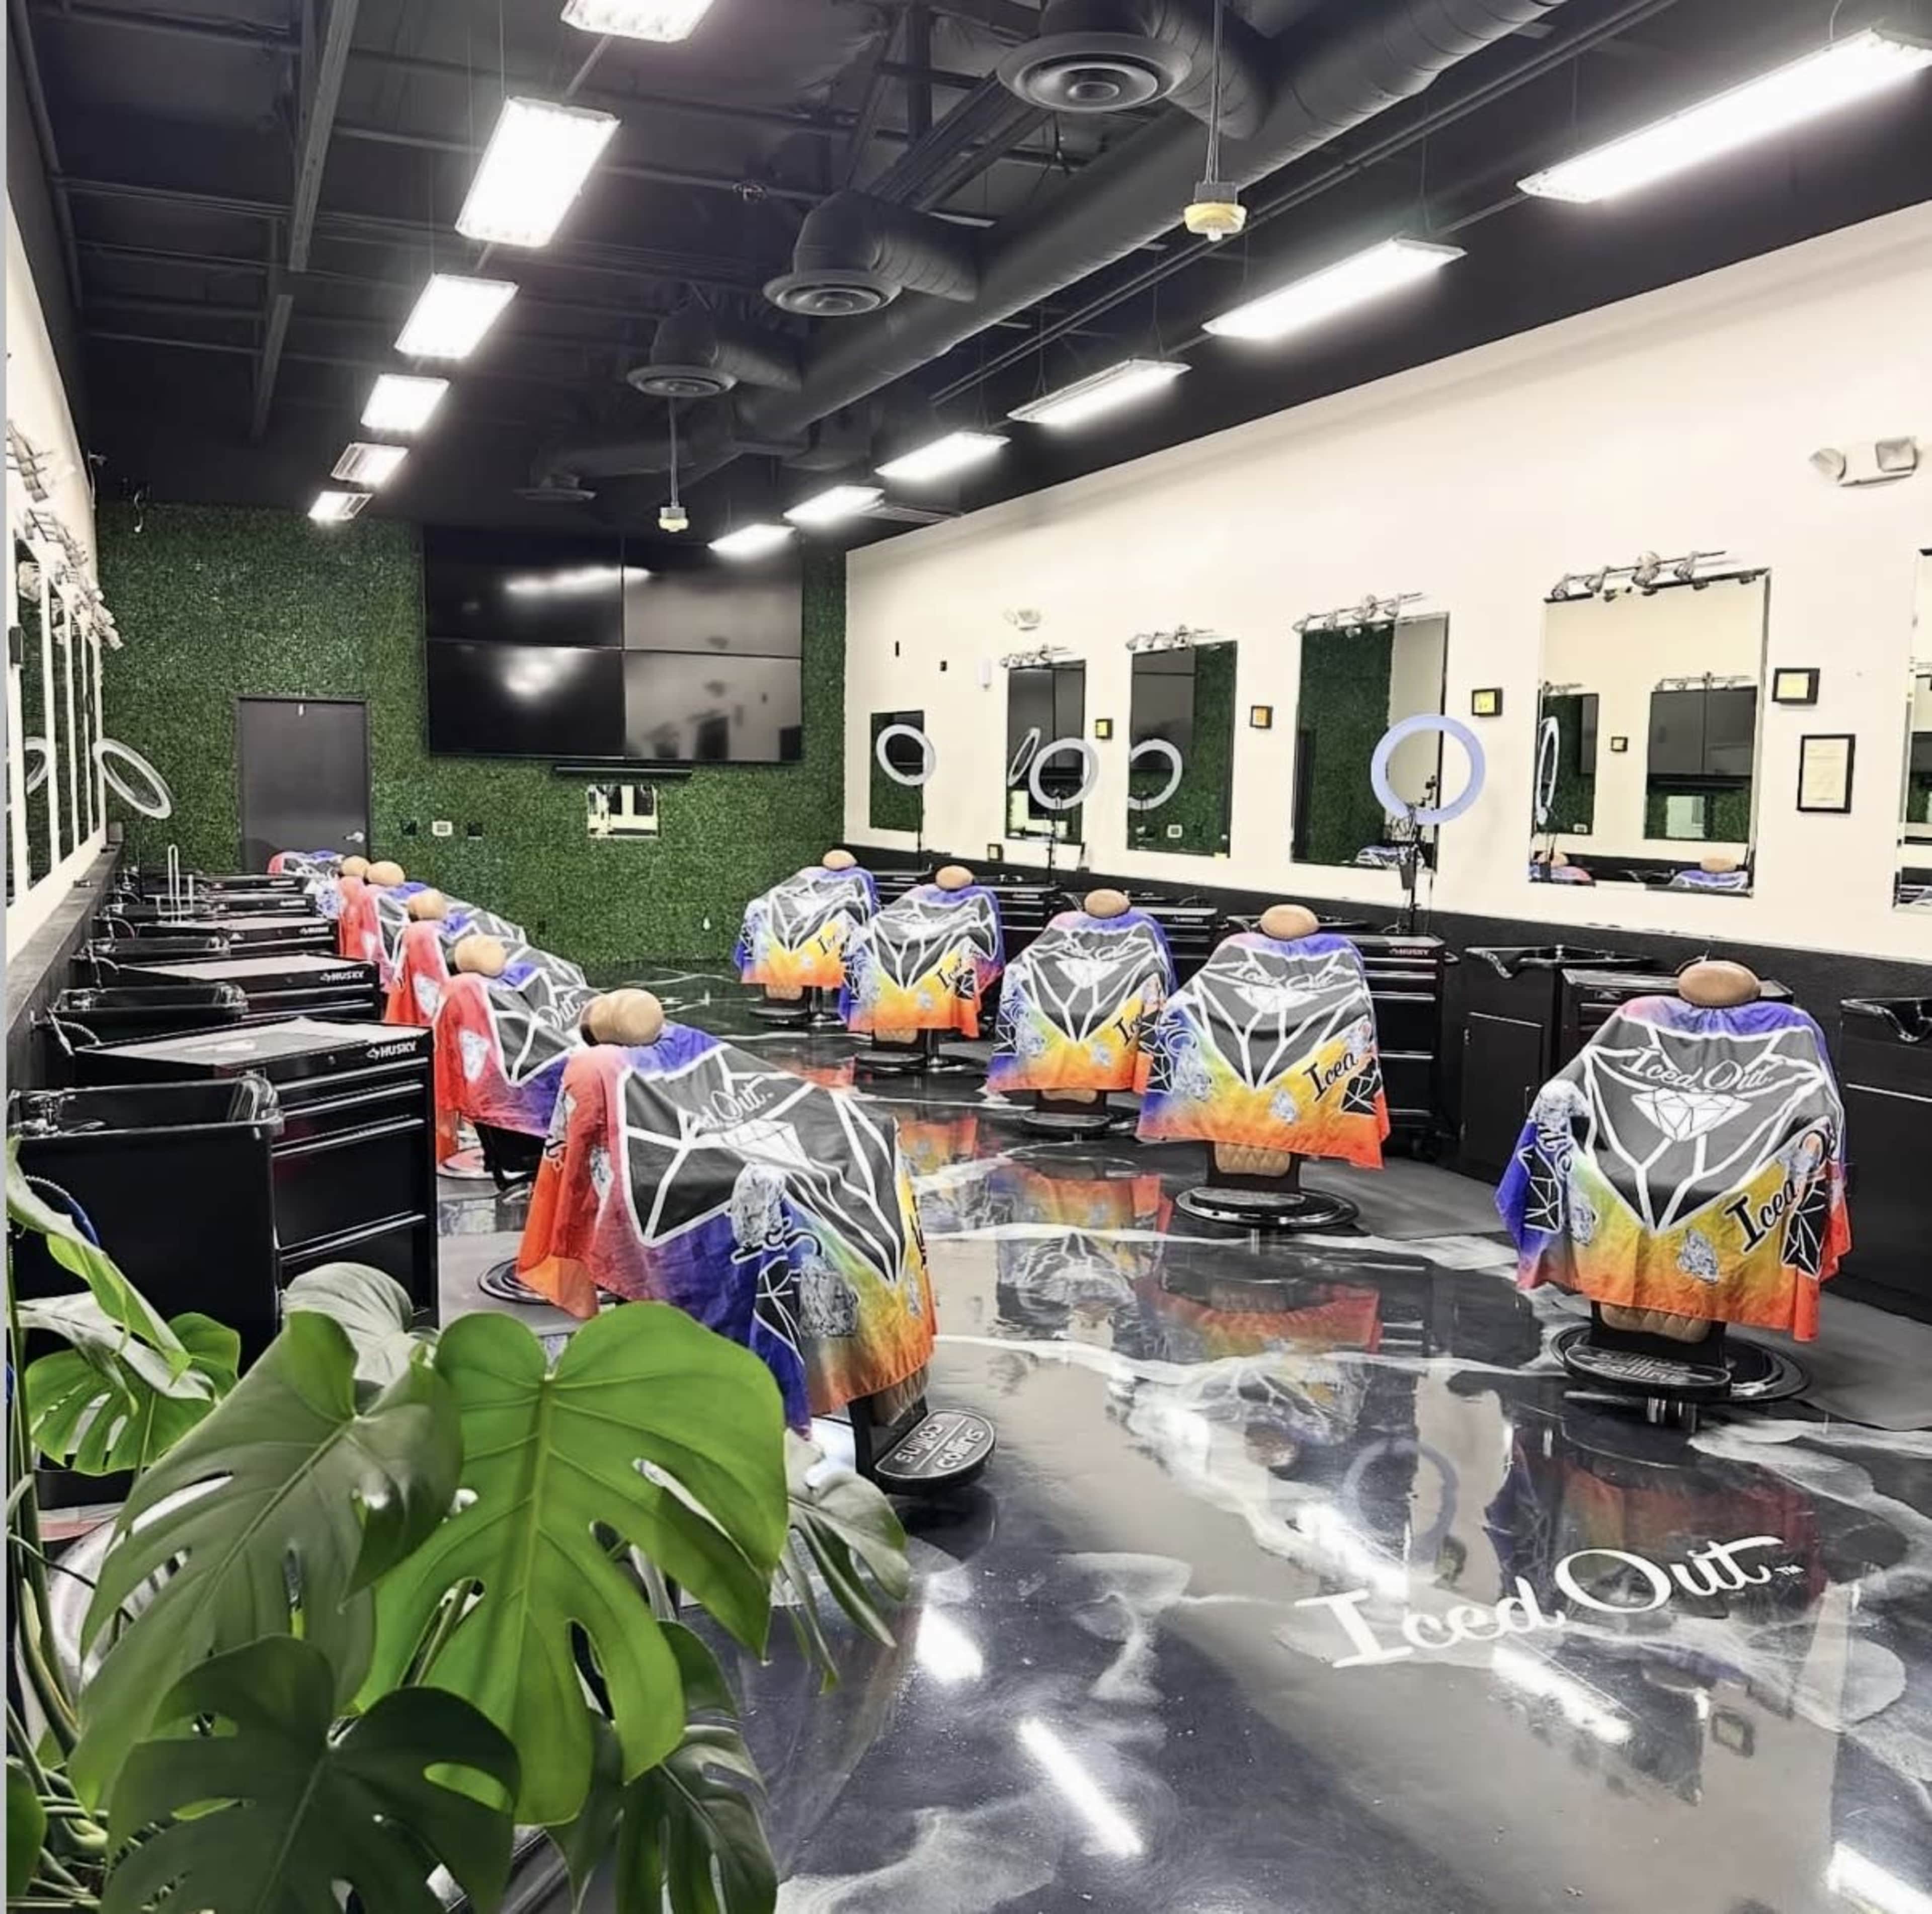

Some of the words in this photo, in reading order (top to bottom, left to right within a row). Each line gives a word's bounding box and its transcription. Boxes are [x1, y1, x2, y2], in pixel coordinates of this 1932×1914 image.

[331, 970, 364, 980] HUSKY
[381, 1041, 417, 1058] HUSKY
[1620, 1046, 1704, 1092] Iced
[710, 1075, 766, 1121] Out
[1295, 1576, 1566, 1669] Iced
[1554, 1536, 1784, 1614] Out
